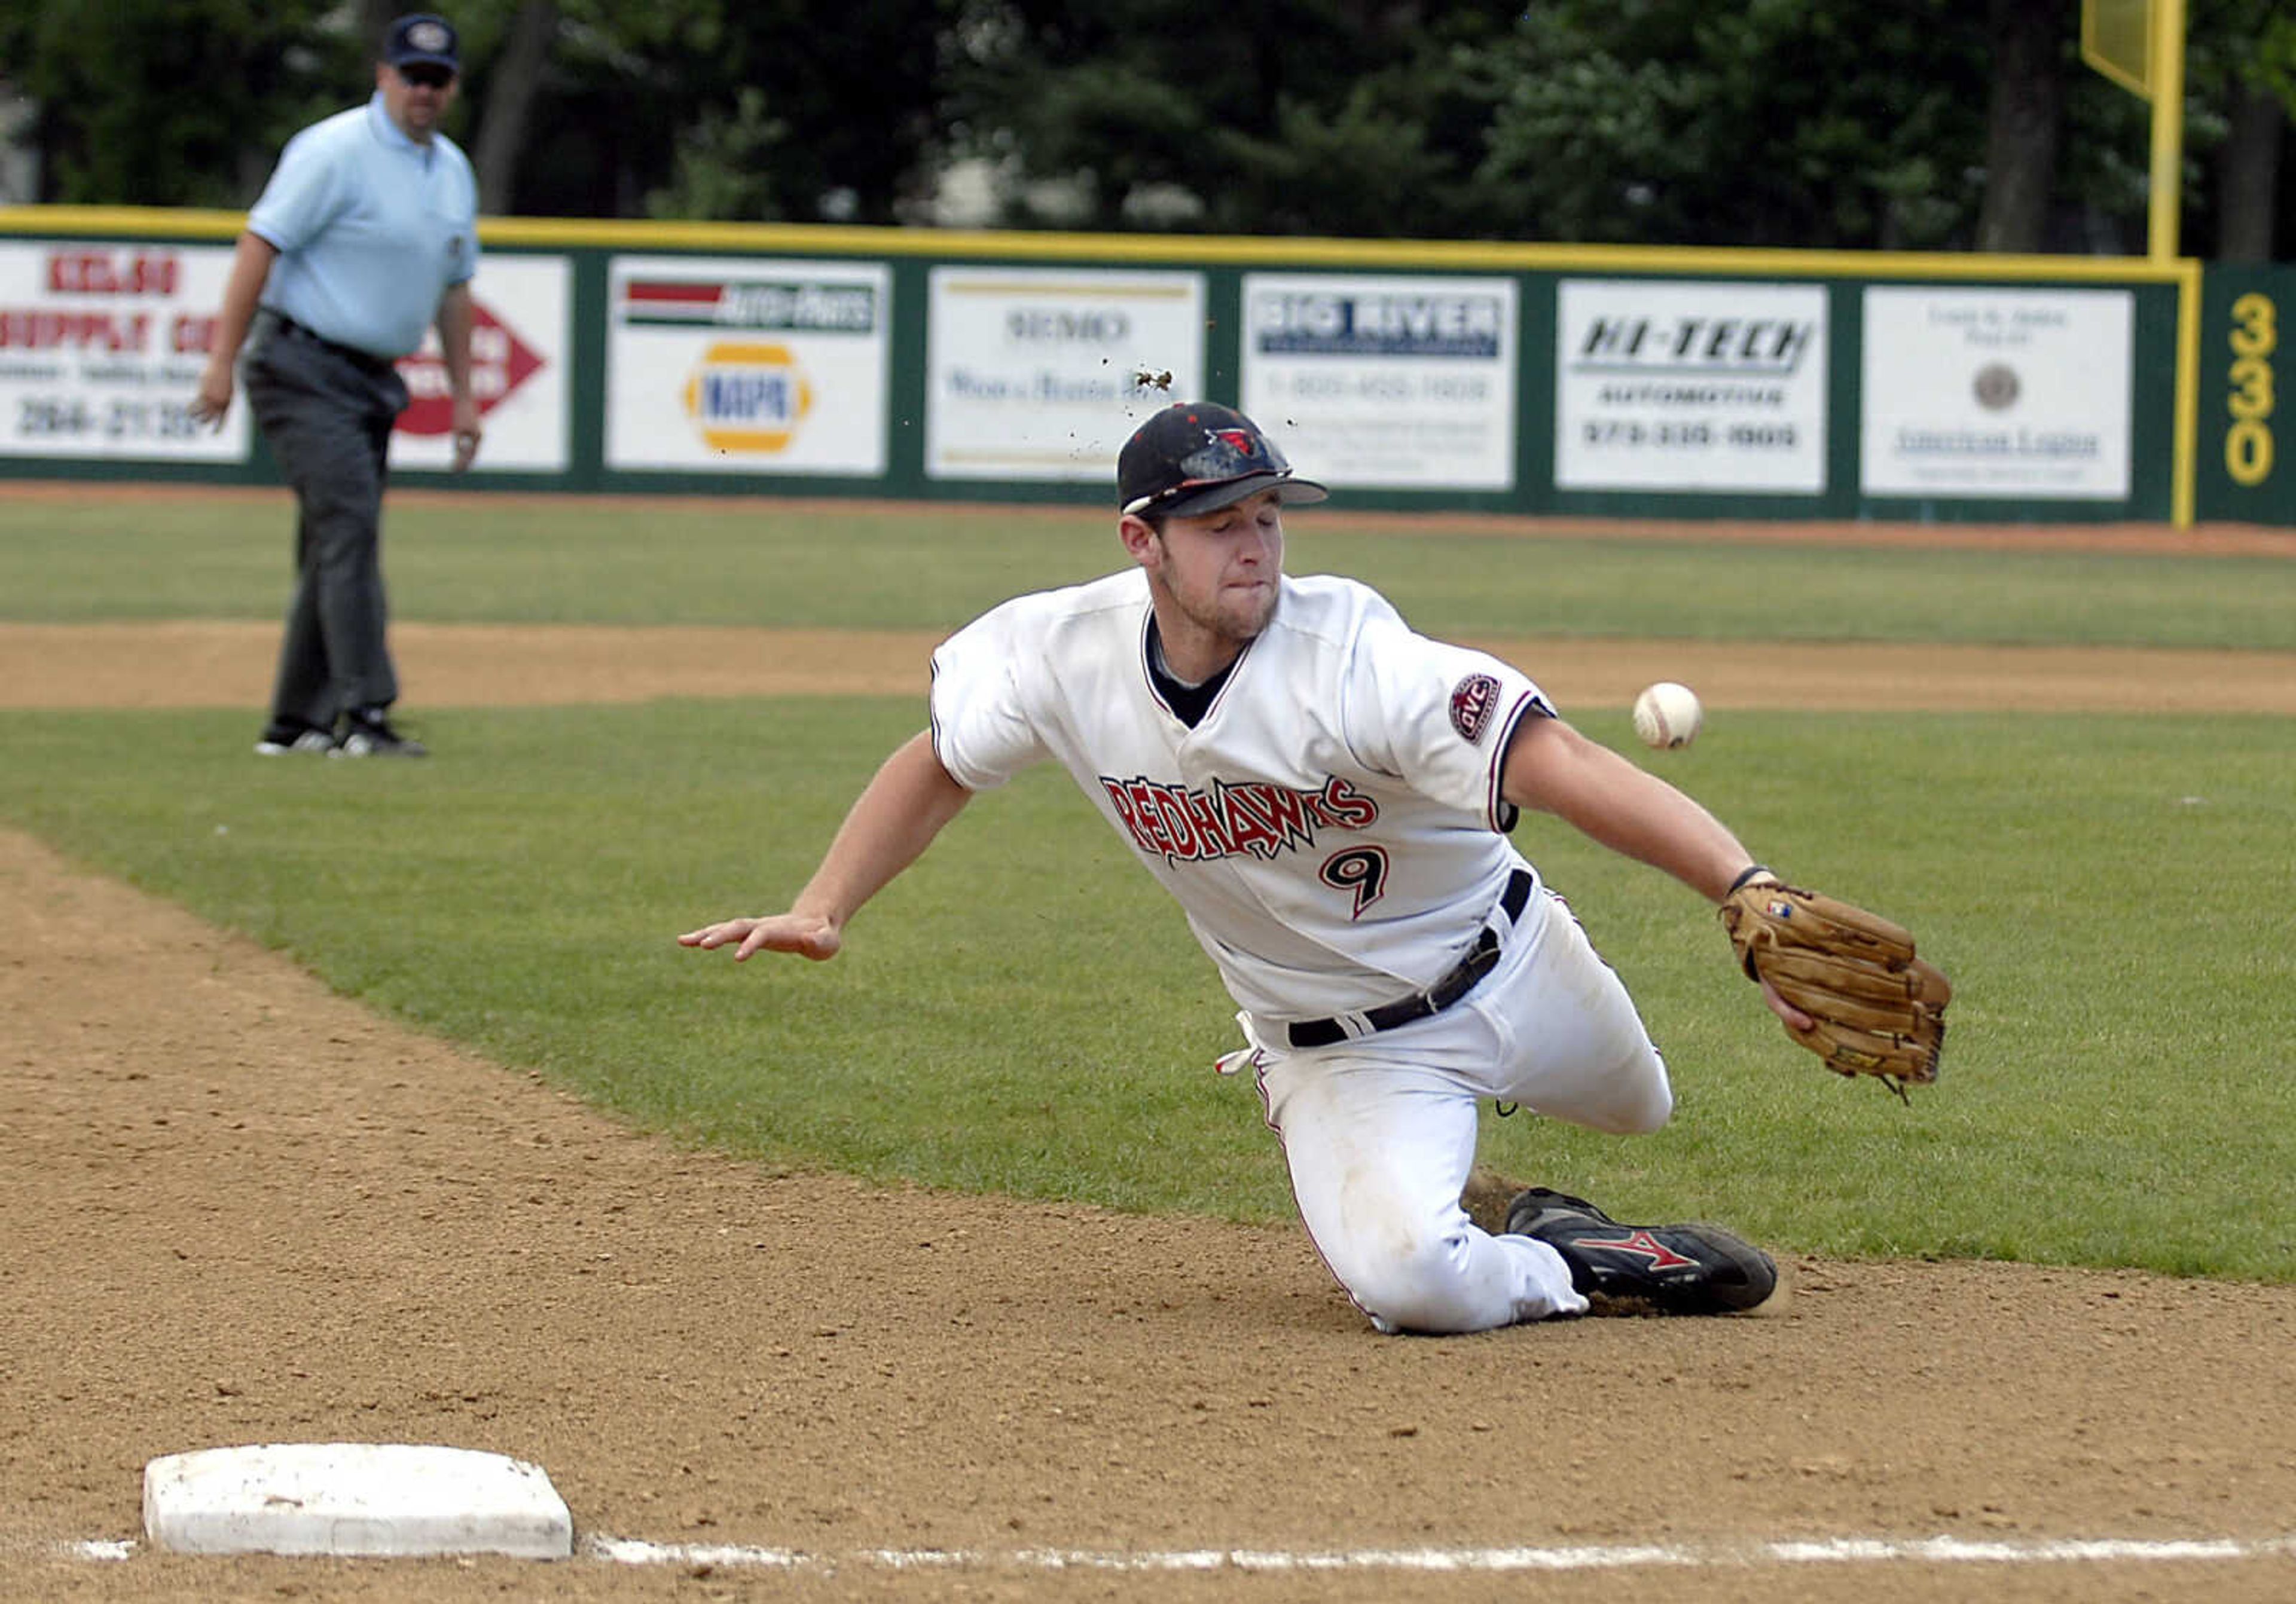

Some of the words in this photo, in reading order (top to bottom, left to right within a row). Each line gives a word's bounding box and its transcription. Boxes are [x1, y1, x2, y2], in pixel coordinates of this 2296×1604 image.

[47, 253, 179, 294] KELSO
[0, 310, 151, 353] SUPPLY
[1355, 298, 1500, 342] RIVER
[1581, 316, 1815, 360] HI-TECH
[703, 373, 789, 420] NAPA
[1598, 383, 1785, 408] AUTOMOTIVE
[2225, 292, 2277, 487] 330
[1099, 775, 1379, 870] REDHAWKS
[1319, 845, 1388, 921] 9
